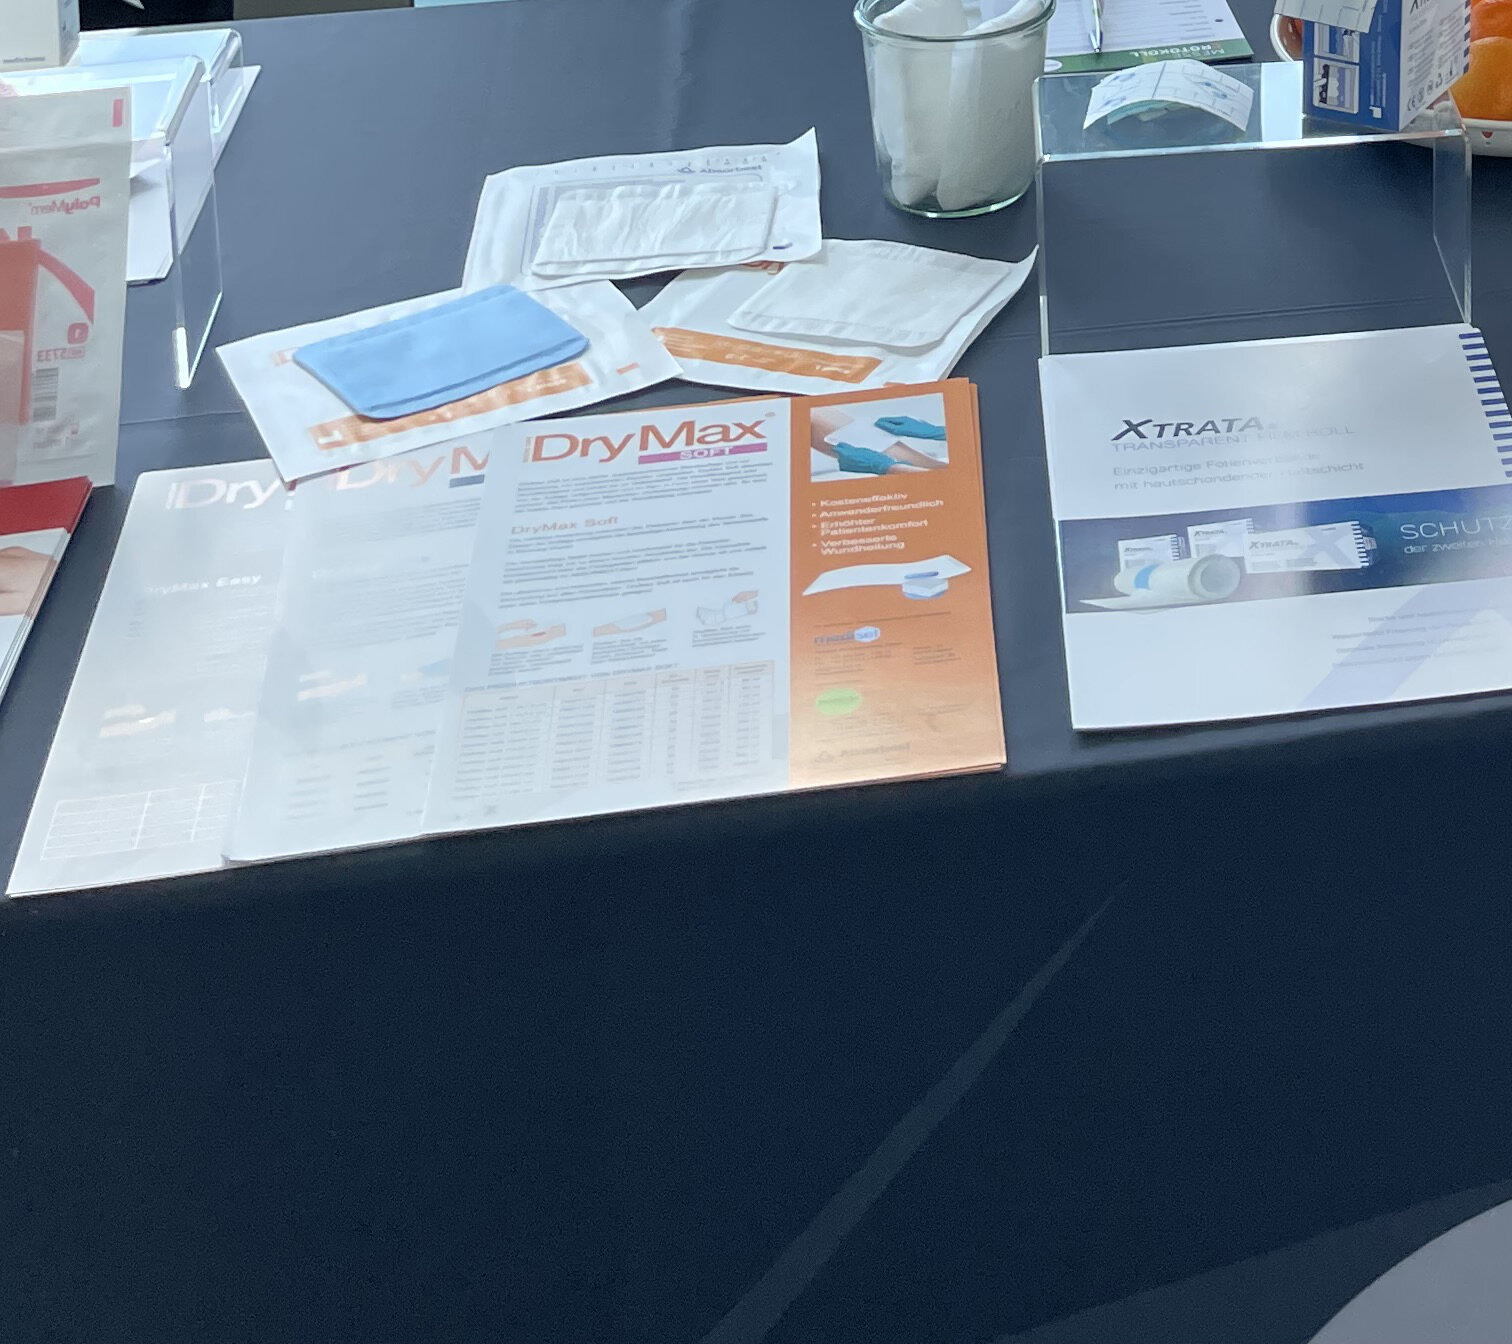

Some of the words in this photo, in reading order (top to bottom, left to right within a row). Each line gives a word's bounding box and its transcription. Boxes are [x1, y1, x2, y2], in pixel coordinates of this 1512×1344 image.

[1110, 415, 1266, 442] XTRATA
[531, 419, 769, 463] DryMax
[1111, 433, 1250, 453] TRANSPARENT
[679, 446, 735, 461] SOFT
[1112, 460, 1203, 477] Einzigartige
[1113, 479, 1140, 491] mit
